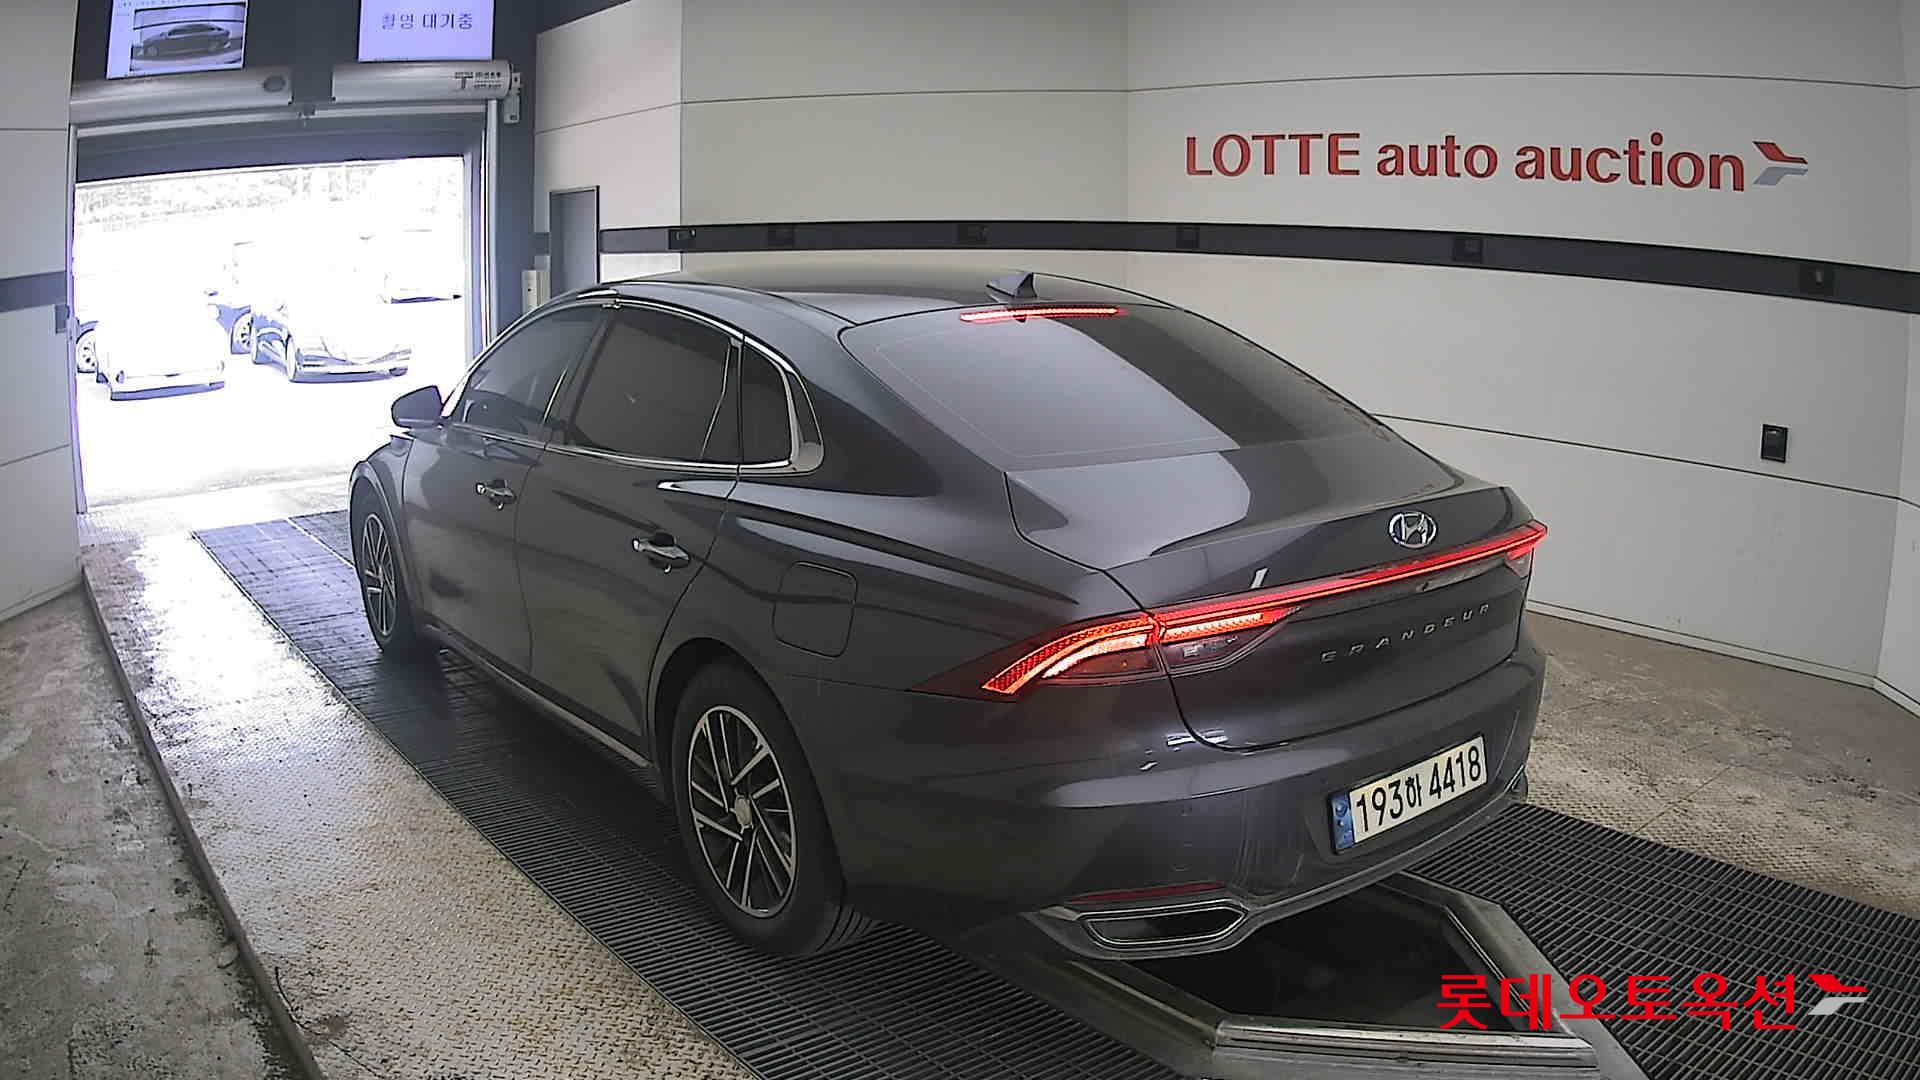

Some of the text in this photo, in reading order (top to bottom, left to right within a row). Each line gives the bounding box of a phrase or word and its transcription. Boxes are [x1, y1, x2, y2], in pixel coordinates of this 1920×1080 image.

[422, 13, 473, 30] 대기중
[1186, 132, 1745, 191] LOTTE auto auction
[1320, 604, 1489, 662] GRANDEUR
[1356, 745, 1481, 832] 193하 4418
